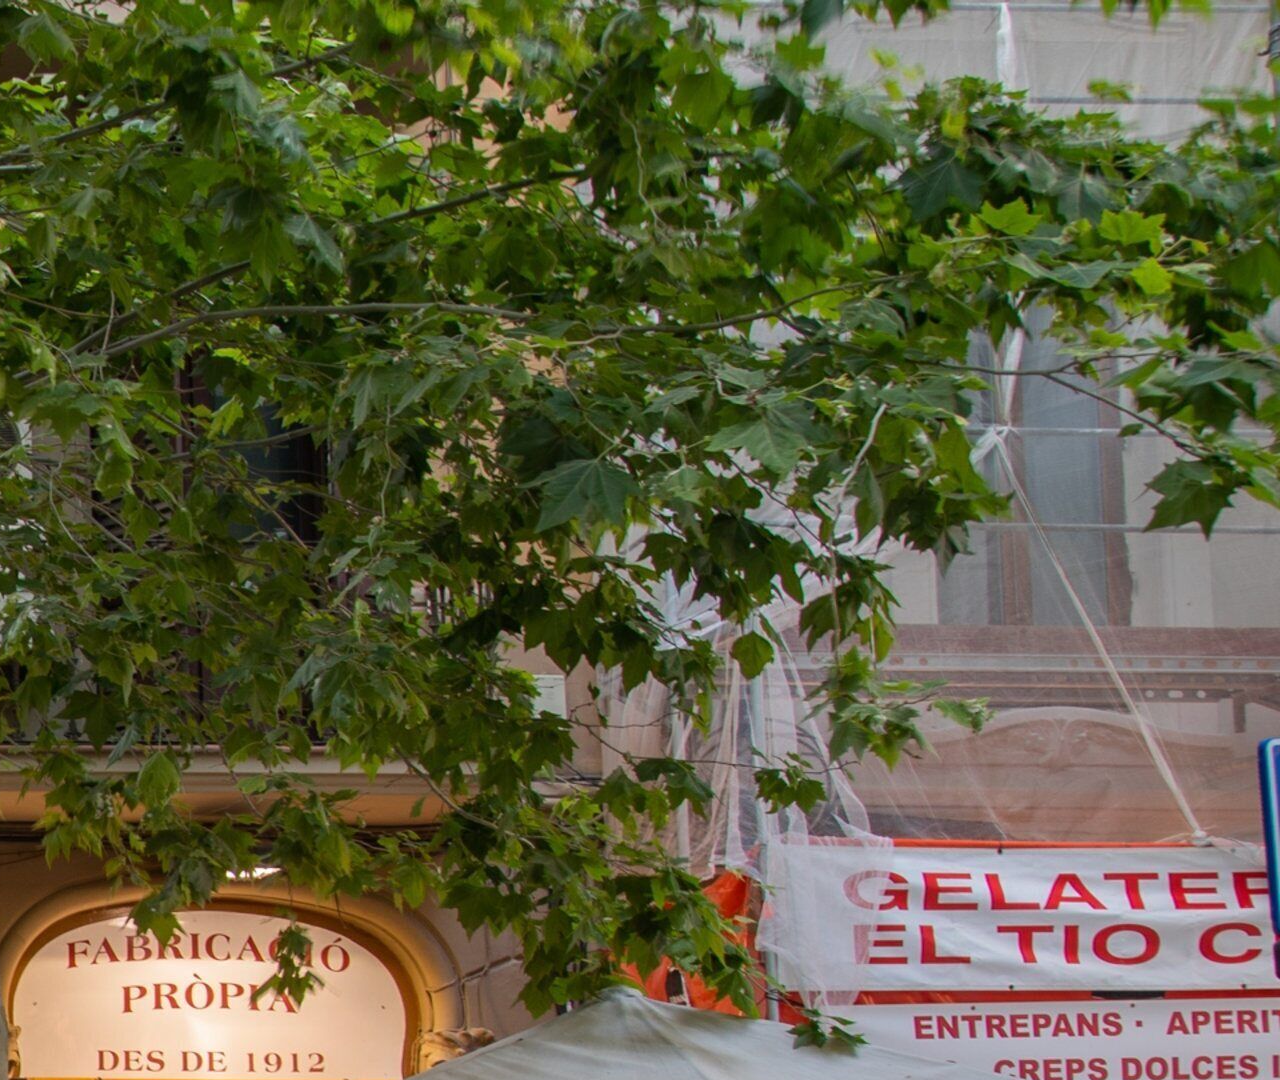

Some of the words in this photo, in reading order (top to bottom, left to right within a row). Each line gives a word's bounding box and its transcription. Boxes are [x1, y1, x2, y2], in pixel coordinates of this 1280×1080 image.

[854, 923, 972, 965] EL
[997, 923, 1161, 965] TIO
[121, 973, 299, 1014] PRÒPIA
[912, 1010, 1124, 1040] ENTREPANS
[96, 1050, 165, 1072] DES
[180, 1051, 228, 1072] DE
[246, 1052, 325, 1073] 1912
